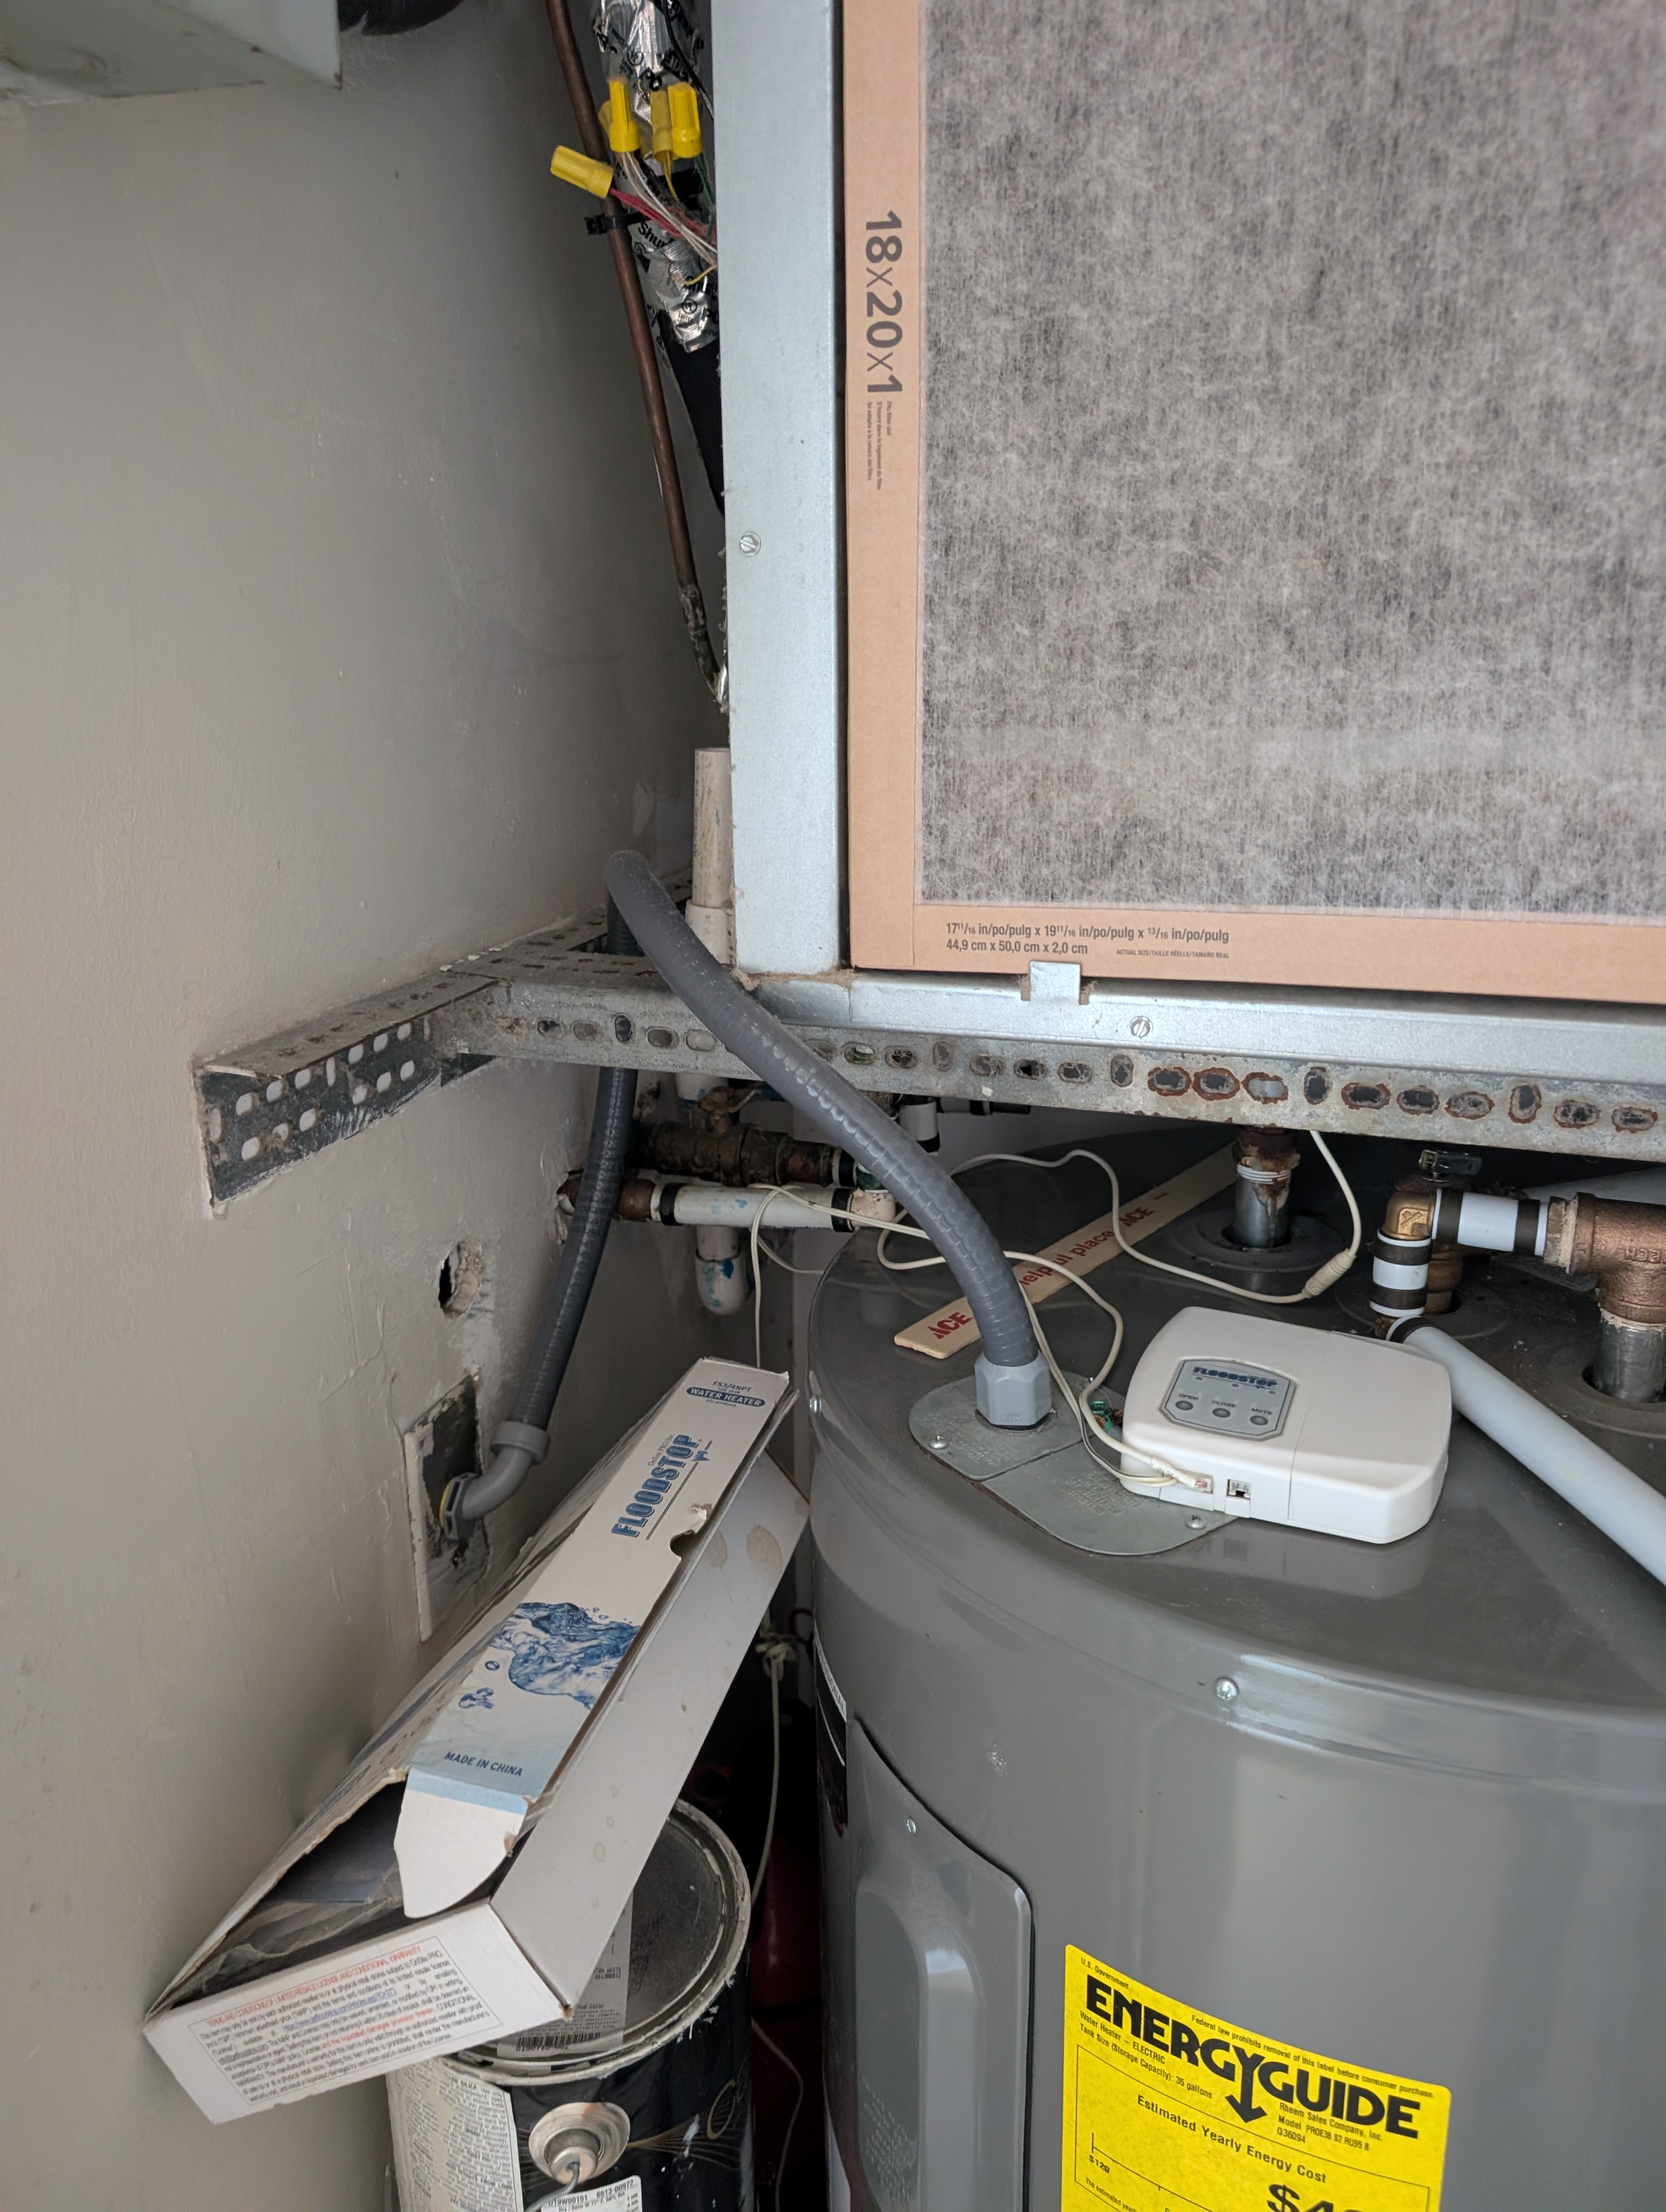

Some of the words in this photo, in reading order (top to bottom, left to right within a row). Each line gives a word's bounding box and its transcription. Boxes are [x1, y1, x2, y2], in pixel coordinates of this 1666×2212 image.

[946, 939, 968, 952] 44,9
[971, 941, 986, 951] cm
[990, 942, 996, 951] x
[999, 941, 1021, 954] 50,0
[1024, 943, 1040, 953] cm
[1043, 944, 1049, 953] x
[1052, 942, 1068, 955] 2,0
[1072, 944, 1088, 954] cm
[978, 923, 1031, 938] in/po/pulg
[1035, 927, 1041, 936] x
[1079, 925, 1134, 941] in/po/pulg
[1137, 929, 1144, 938] x
[1171, 928, 1229, 944] in/po/pulg
[1119, 1206, 1155, 1227] ACE
[1070, 1231, 1114, 1256] place
[928, 1311, 974, 1339] ACE
[1194, 1367, 1277, 1387] FLOODSTOP
[690, 1388, 722, 1399] WATER
[723, 1394, 761, 1406] HEATER
[611, 1435, 700, 1538] FLOODSTOP
[444, 1752, 475, 1765] MADE
[477, 1759, 488, 1768] IN
[490, 1761, 523, 1776] CHINA
[1081, 1957, 1092, 1970] U.S.
[1094, 1966, 1129, 1989] Government
[1080, 2010, 1098, 2028] Water
[1100, 2024, 1122, 2041] Heater
[1132, 2041, 1165, 2065] ELECTRIC
[1080, 2023, 1095, 2039] Tank
[1097, 2033, 1110, 2047] Size
[1111, 2042, 1138, 2064] (Storage
[1140, 2059, 1173, 2082] Capacity):
[1176, 2076, 1184, 2086] 35
[1187, 2081, 1212, 2099] gallons
[1191, 2015, 1215, 2031] Federal
[1218, 2026, 1229, 2036] law
[1232, 2033, 1261, 2049] prohibits
[1263, 2044, 1290, 2059] removal
[1302, 2057, 1315, 2067] this
[1317, 2061, 1334, 2073] label
[1337, 2067, 1359, 2080] before
[1362, 2075, 1396, 2090] consumer
[1399, 2085, 1435, 2099] purchase.
[1278, 2115, 1302, 2130] Model
[1334, 2133, 1342, 2143] S2
[1279, 2102, 1304, 2117] Rheem
[1307, 2110, 1327, 2125] Sales
[1329, 2119, 1366, 2138] Company,
[1369, 2130, 1383, 2141] Inc.
[1138, 2094, 1196, 2132] Estimated
[1201, 2125, 1241, 2152] Yearly
[1247, 2145, 1292, 2172] Energy
[1297, 2165, 1327, 2183] Cost
[1088, 2155, 1110, 2174] $120
[1086, 2177, 1094, 2188] The
[1096, 2185, 1121, 2205] estimated
